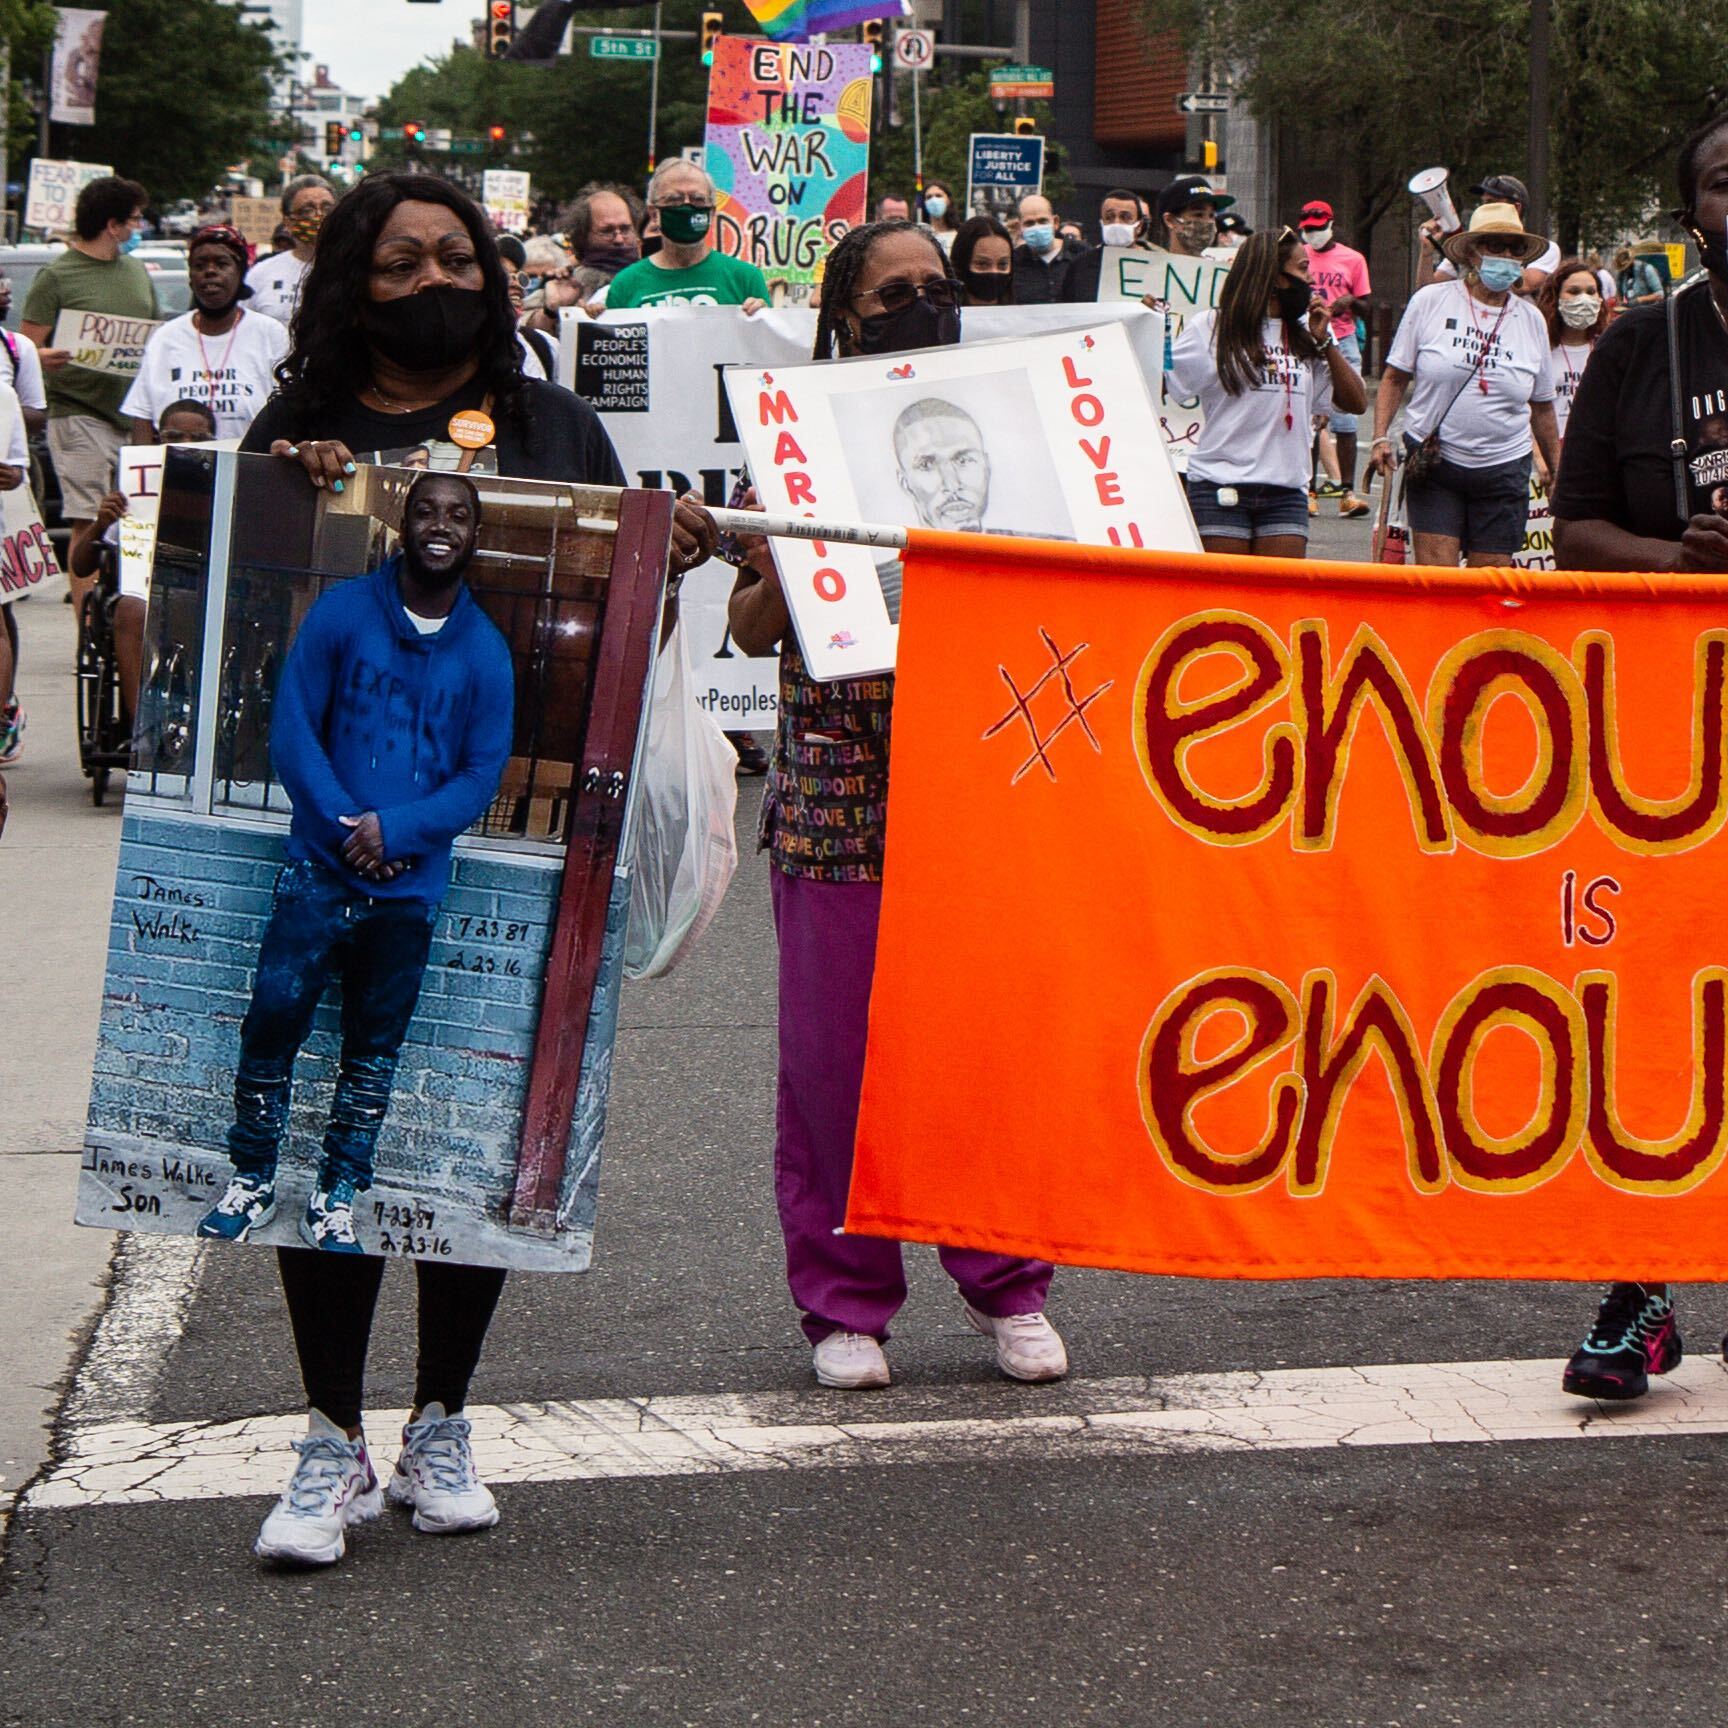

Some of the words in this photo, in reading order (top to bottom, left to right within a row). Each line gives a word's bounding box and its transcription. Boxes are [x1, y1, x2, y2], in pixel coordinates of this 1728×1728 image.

[600, 41, 628, 54] 5th
[635, 42, 652, 55] St
[752, 47, 835, 83] END
[757, 90, 824, 125] THE
[742, 130, 835, 179] WAR
[975, 150, 1023, 161] LIBERTY
[985, 161, 1032, 171] JUSTICE
[995, 171, 1016, 181] ALL
[768, 181, 805, 206] ON
[80, 313, 155, 345] PROTECT
[615, 327, 648, 339] POOR
[593, 340, 648, 352] PEOPLE'S
[582, 354, 649, 367] ECONOMIC
[603, 369, 649, 381] HUMAN
[179, 383, 254, 399] PEOPLE'S
[603, 383, 649, 395] RIGHTS
[583, 395, 650, 407] CAMPAIGN
[1061, 356, 1125, 507] LOVE
[799, 774, 867, 797] SUPPORT
[112, 1184, 161, 1216] Son
